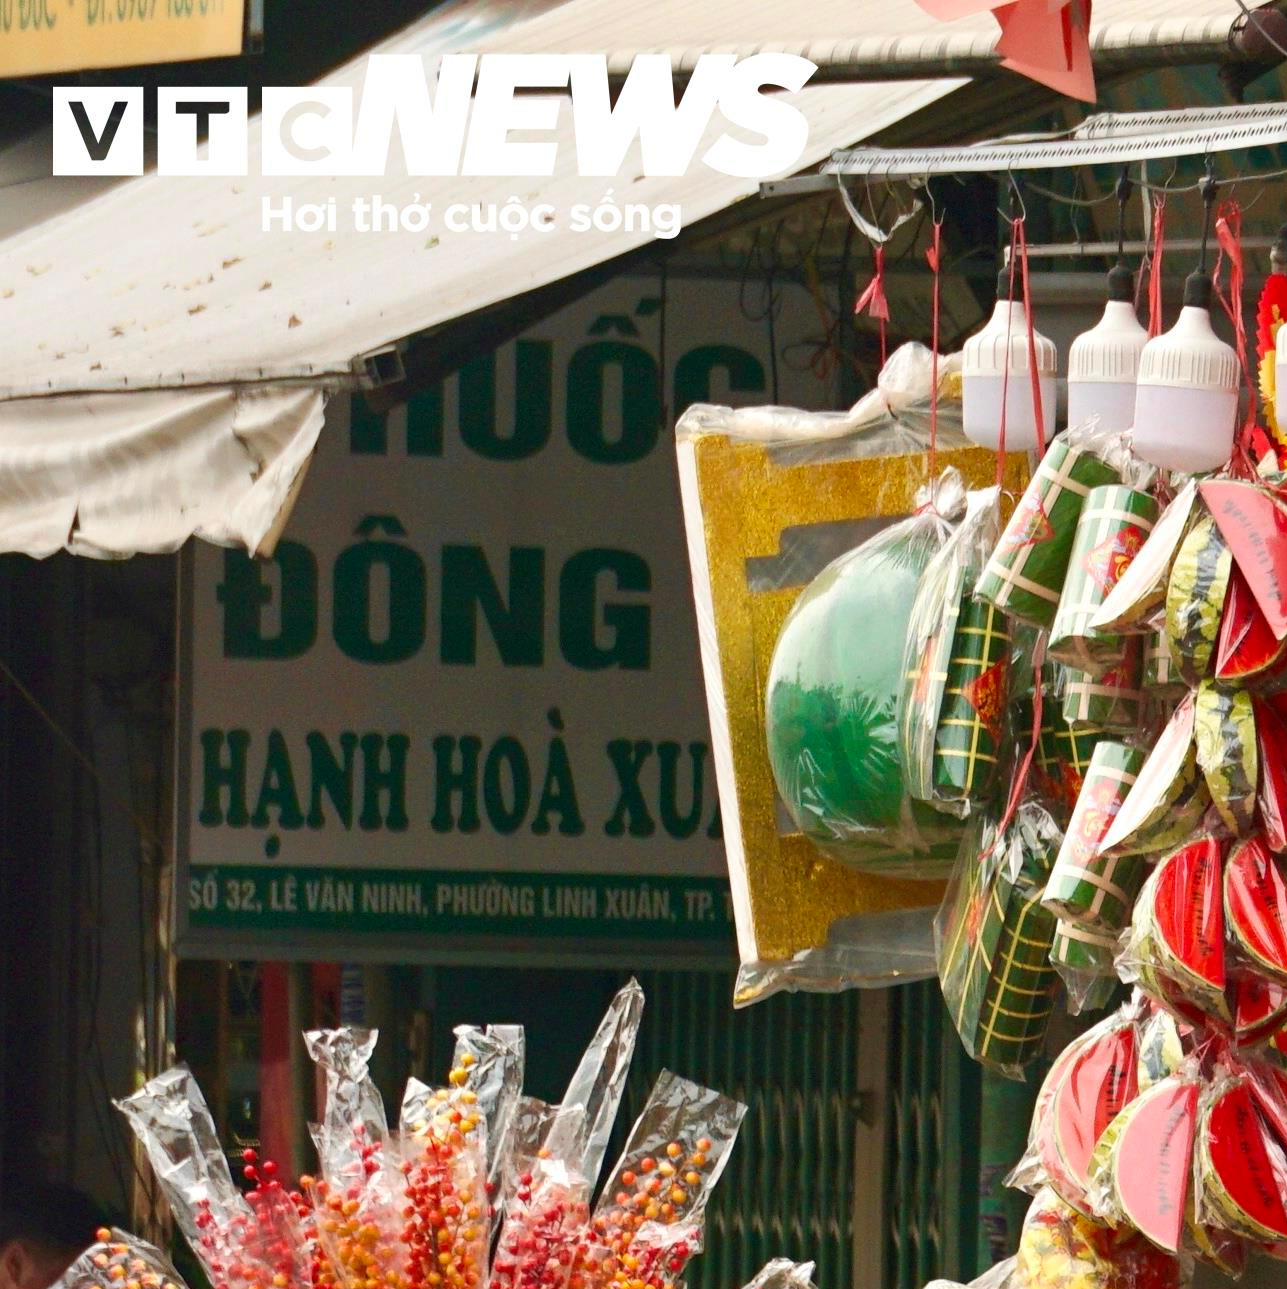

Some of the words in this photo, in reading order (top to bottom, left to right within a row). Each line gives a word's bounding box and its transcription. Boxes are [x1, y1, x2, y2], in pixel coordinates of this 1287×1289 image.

[216, 514, 652, 671] ĐÔNG
[199, 729, 411, 858] HẠNH
[431, 707, 586, 837] HOÀ
[606, 738, 722, 840] XU
[188, 868, 219, 911] SỐ
[225, 879, 262, 914] 32,
[270, 876, 298, 913] LÊ
[304, 877, 355, 914] VĂN
[435, 878, 535, 918] PHƯỜNG
[543, 888, 598, 919] LINH
